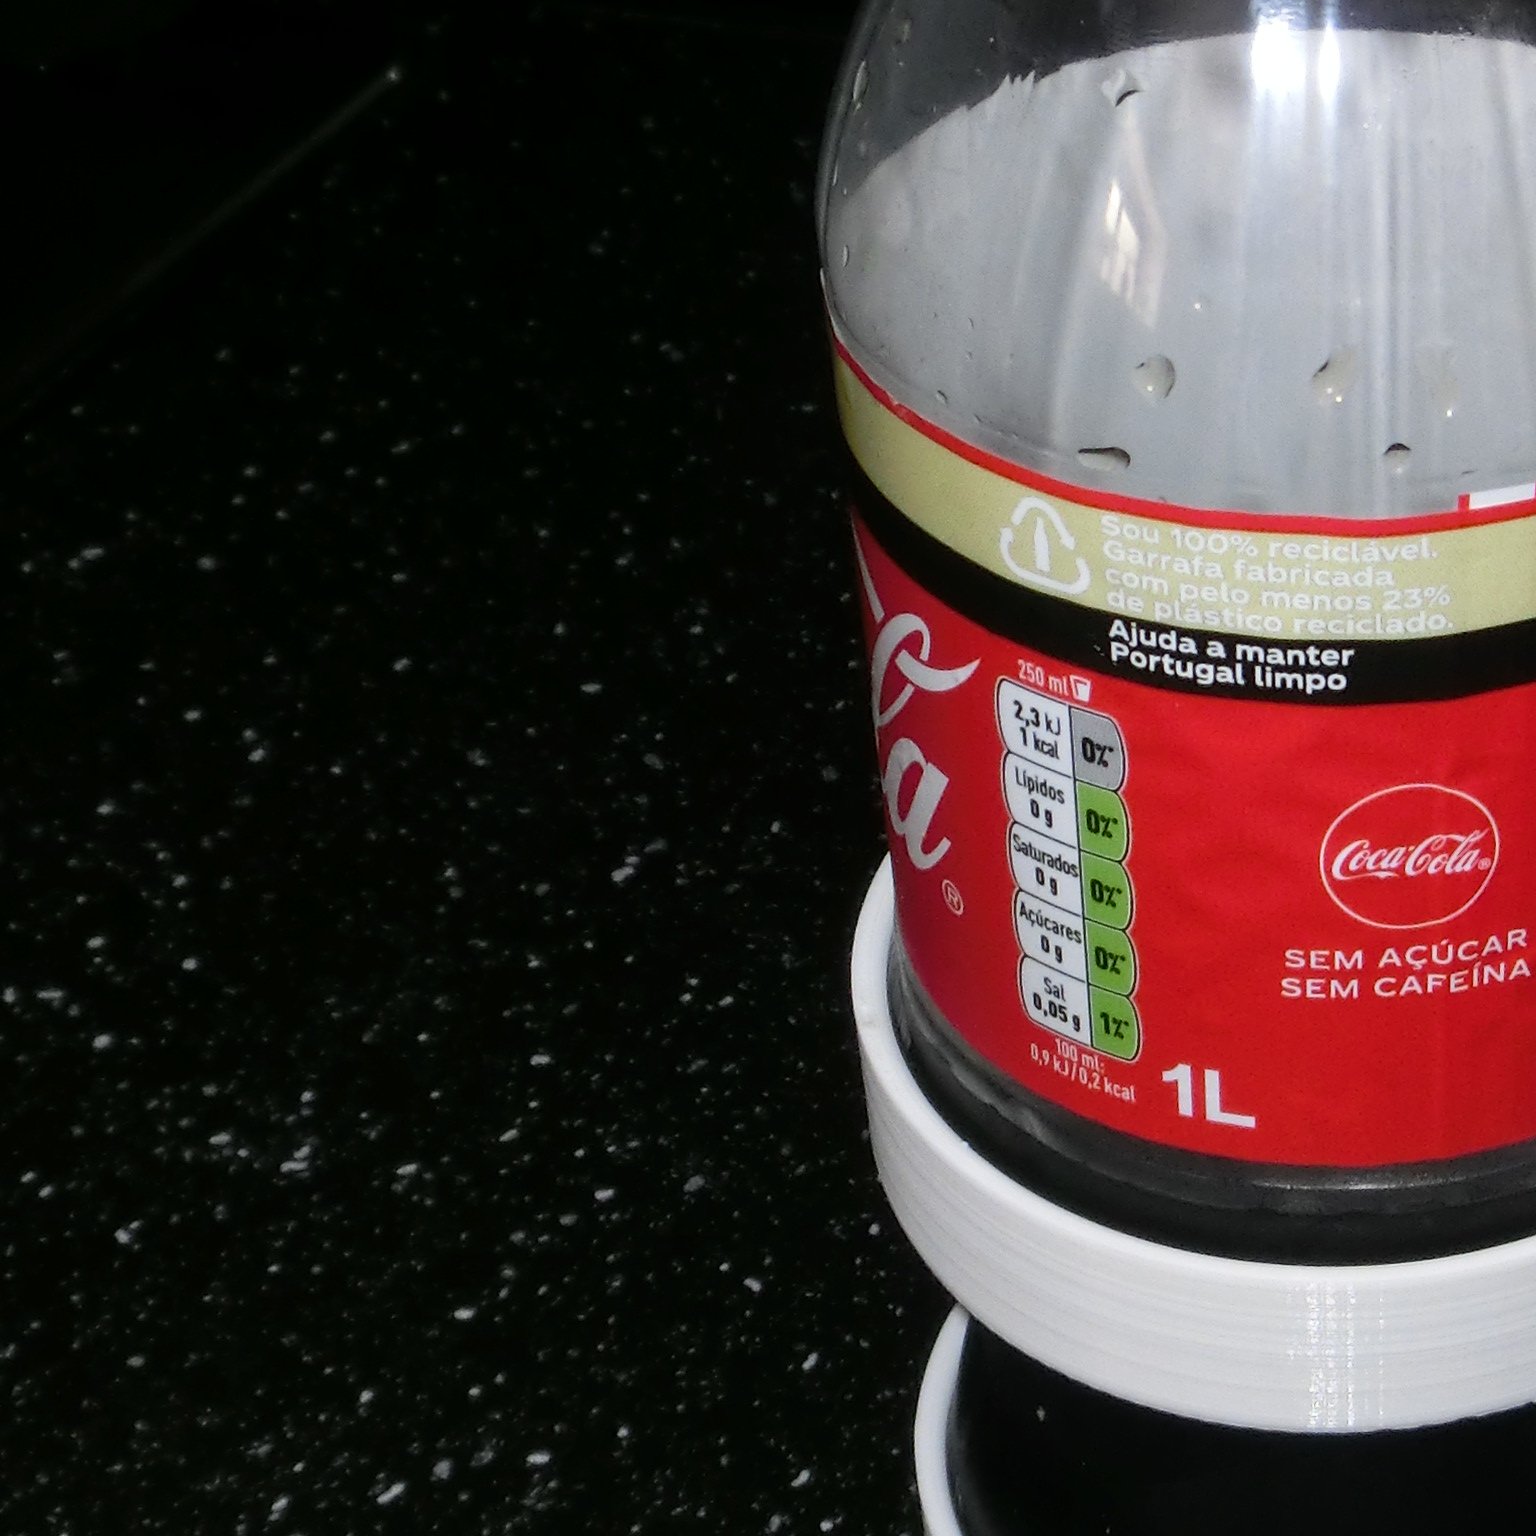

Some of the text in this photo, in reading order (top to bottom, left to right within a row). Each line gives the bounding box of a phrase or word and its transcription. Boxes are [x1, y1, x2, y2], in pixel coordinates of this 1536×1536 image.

[1101, 514, 1438, 564] Sou 100% reciclável.
[1103, 539, 1395, 587] Garrafa fabricada
[1105, 568, 1452, 611] com pelo menos 23%
[1107, 589, 1454, 635] de plástico reciclado.
[1108, 619, 1355, 667] Ajuda a manter
[1017, 659, 1069, 696] 250 ml
[1110, 641, 1349, 695] Portugal limpo
[1013, 699, 1040, 727] 2,3
[1020, 727, 1060, 760] 1 kcal
[1015, 765, 1065, 804] Lípidos
[1030, 798, 1053, 828] 0 g
[1013, 832, 1079, 878] Saturados
[1035, 866, 1058, 896] 0 g
[1019, 901, 1082, 944] Açúcares
[1041, 935, 1063, 964] 0 g
[1284, 928, 1528, 971] SEM AÇÚCAR
[1043, 977, 1066, 1002] Sal
[1281, 958, 1531, 999] SEM CAFEÍNA
[1033, 992, 1081, 1032] 0,05 g
[1055, 1038, 1078, 1061] 100
[1030, 1043, 1050, 1066] 0,9
[1104, 1076, 1136, 1104] kcal
